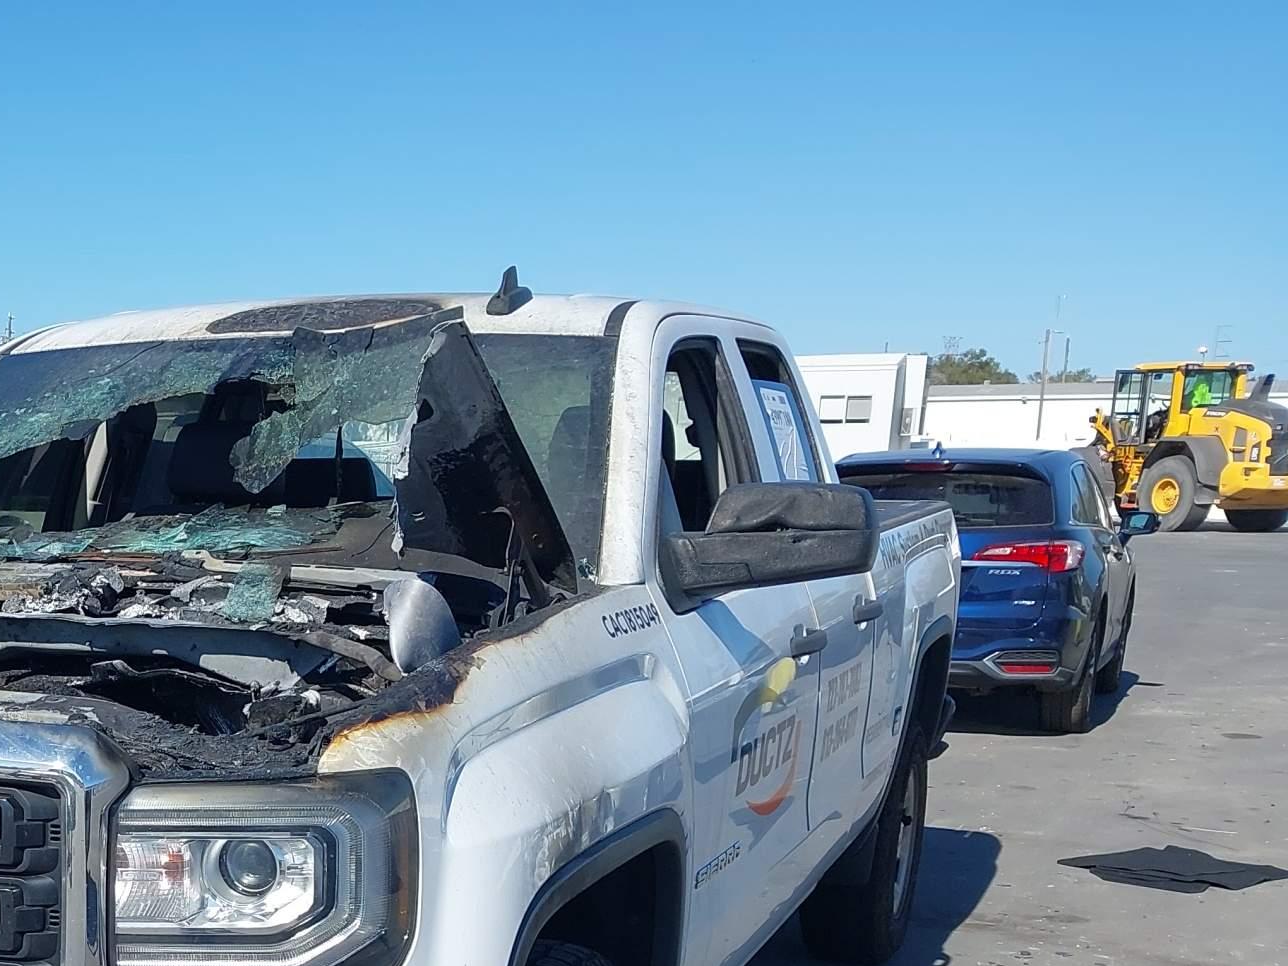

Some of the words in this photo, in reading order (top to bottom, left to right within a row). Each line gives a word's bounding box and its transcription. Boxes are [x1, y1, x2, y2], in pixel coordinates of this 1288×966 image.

[988, 568, 1023, 576] RDX
[601, 602, 661, 639] CAC1815049
[735, 714, 796, 797] DUCTZ
